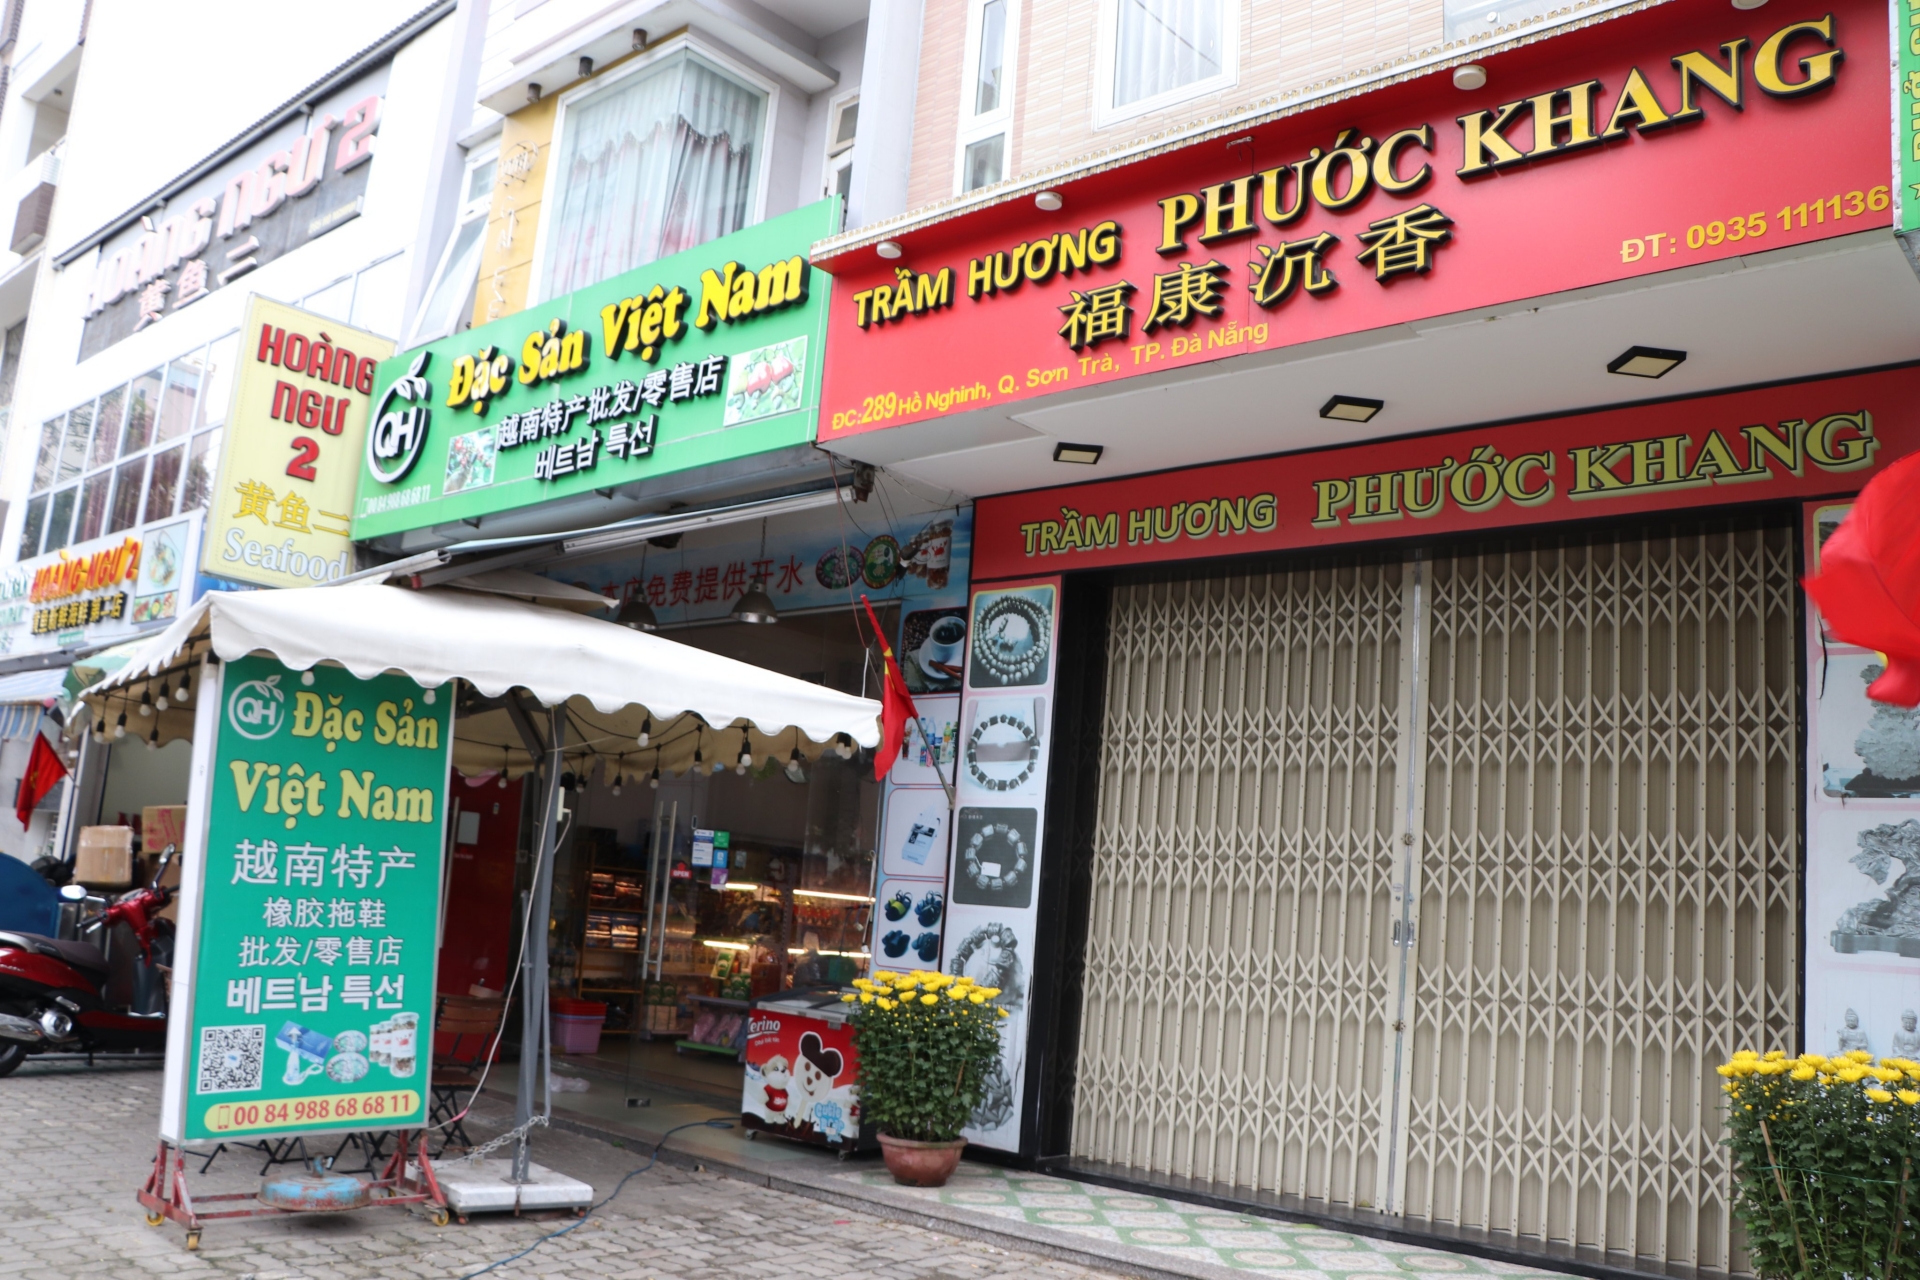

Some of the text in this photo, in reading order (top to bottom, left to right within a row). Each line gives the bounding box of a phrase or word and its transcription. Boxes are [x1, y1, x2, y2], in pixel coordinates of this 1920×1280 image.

[1156, 124, 1434, 254] PHƯỚC
[1455, 12, 1845, 178] KHANG
[81, 95, 384, 321] HOÀNG NGƯ 2
[1620, 185, 1890, 263] ĐT: 0935 111136
[853, 221, 1119, 327] TRẦM HƯƠNG
[1057, 203, 1451, 350] 福康沉香
[257, 323, 377, 396] HOÀNG
[446, 255, 806, 415] Đặc Sản Việt Nam
[898, 391, 922, 416] Hồ
[925, 382, 992, 411] Nghinh,
[998, 375, 1020, 394] Q.
[1026, 367, 1069, 387] Sơn
[1078, 353, 1120, 376] Trà,
[1130, 343, 1165, 365] TP.
[1171, 333, 1202, 357] Đà
[1207, 321, 1269, 349] Nẵng
[270, 380, 351, 436] NGƯ
[496, 354, 725, 451] 越南特产批发/零售店
[286, 436, 320, 482] 2
[534, 414, 656, 480] 베트남 특선
[232, 478, 350, 537] 黄鱼二
[1020, 409, 1880, 556] TRẦM HƯƠNG PHƯỚC KHANG
[125, 541, 142, 581] 2
[223, 527, 349, 582] Seafood
[236, 696, 277, 726] QH
[291, 691, 439, 752] Đặc Sản
[229, 760, 326, 829] Việt
[337, 769, 433, 823] Nam
[230, 838, 416, 889] 越南特产
[262, 896, 387, 929] 橡胶拖鞋
[238, 935, 404, 968] 批发/零售店
[226, 974, 405, 1014] 베트남 특선
[234, 1094, 410, 1126] 00 84 988 68 68 11
